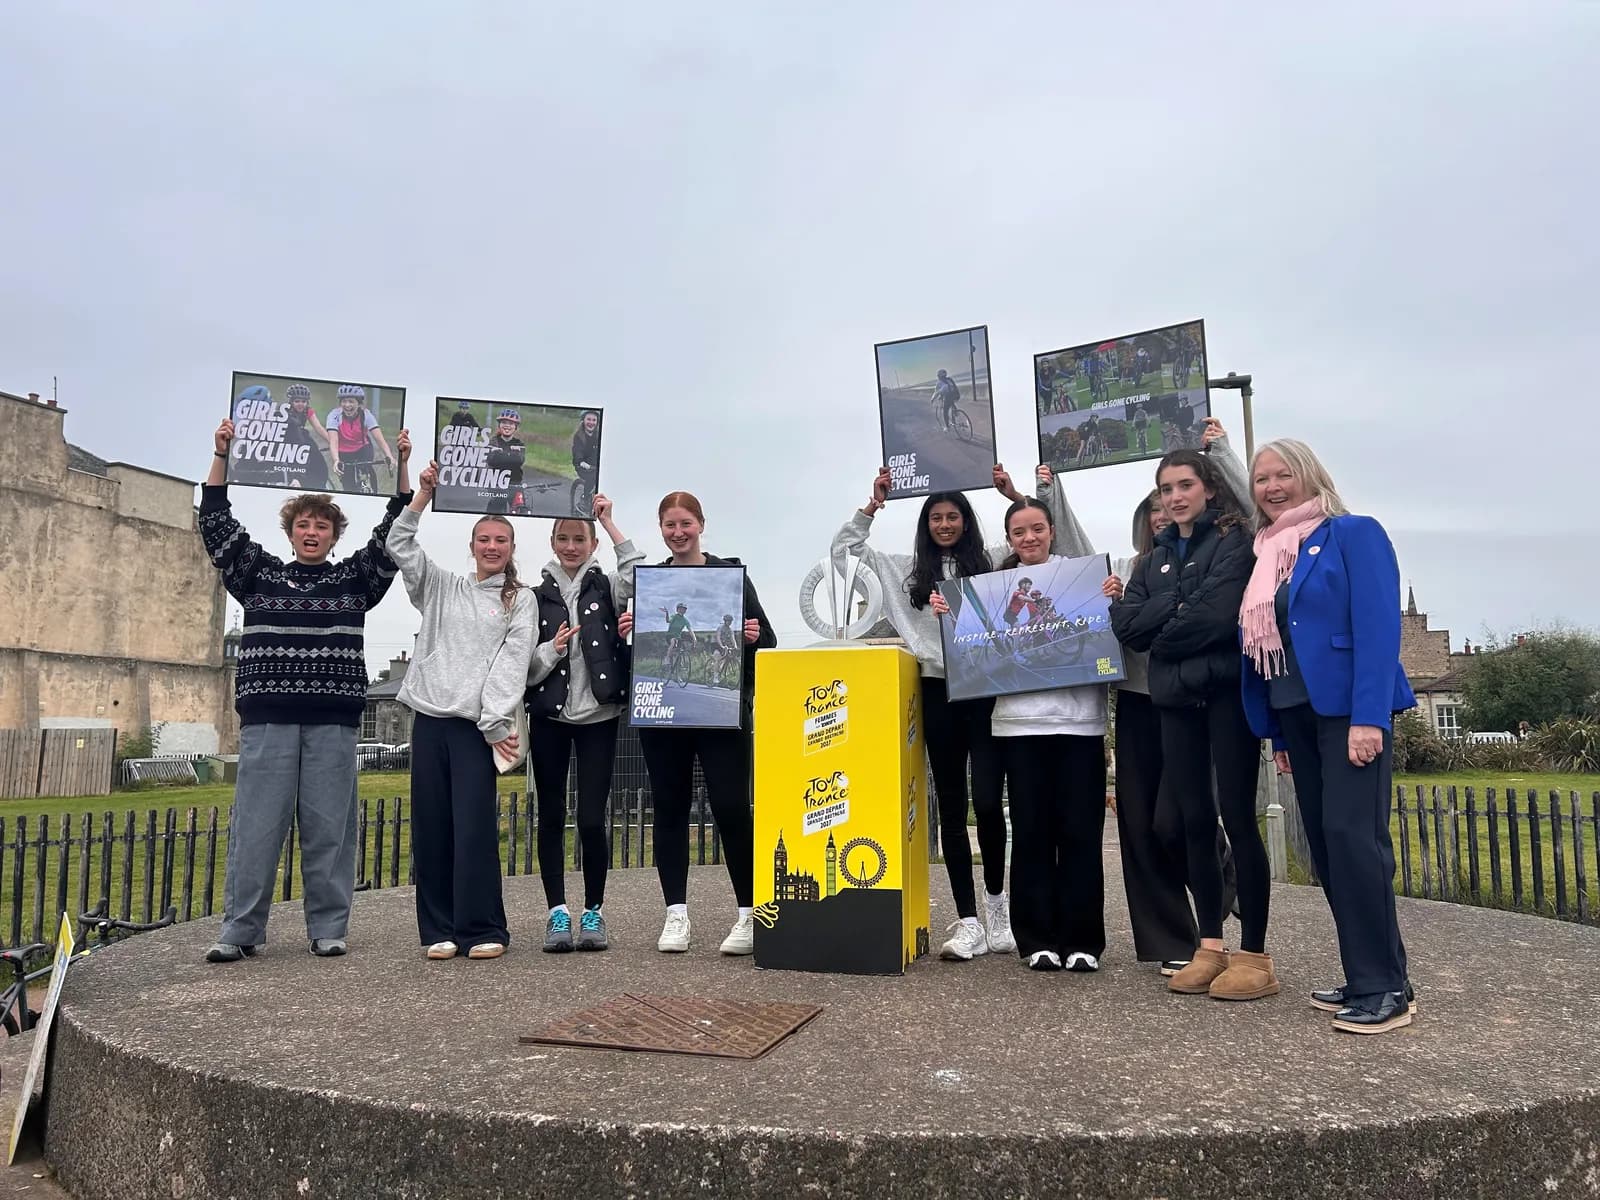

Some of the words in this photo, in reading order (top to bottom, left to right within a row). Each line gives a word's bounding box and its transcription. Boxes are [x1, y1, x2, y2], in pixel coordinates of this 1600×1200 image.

[1108, 398, 1126, 408] GONE
[1126, 392, 1150, 405] CYCLING
[236, 399, 291, 422] GIRLS
[234, 420, 288, 442] GONE
[440, 425, 492, 448] GIRLS
[232, 440, 311, 464] CYCLING
[440, 446, 490, 468] GONE
[888, 453, 916, 468] GIRLS
[438, 466, 512, 489] CYCLING
[890, 465, 916, 478] GONE
[635, 682, 664, 694] GIRLS
[634, 694, 662, 706] GONE
[634, 706, 674, 718] CYCLING
